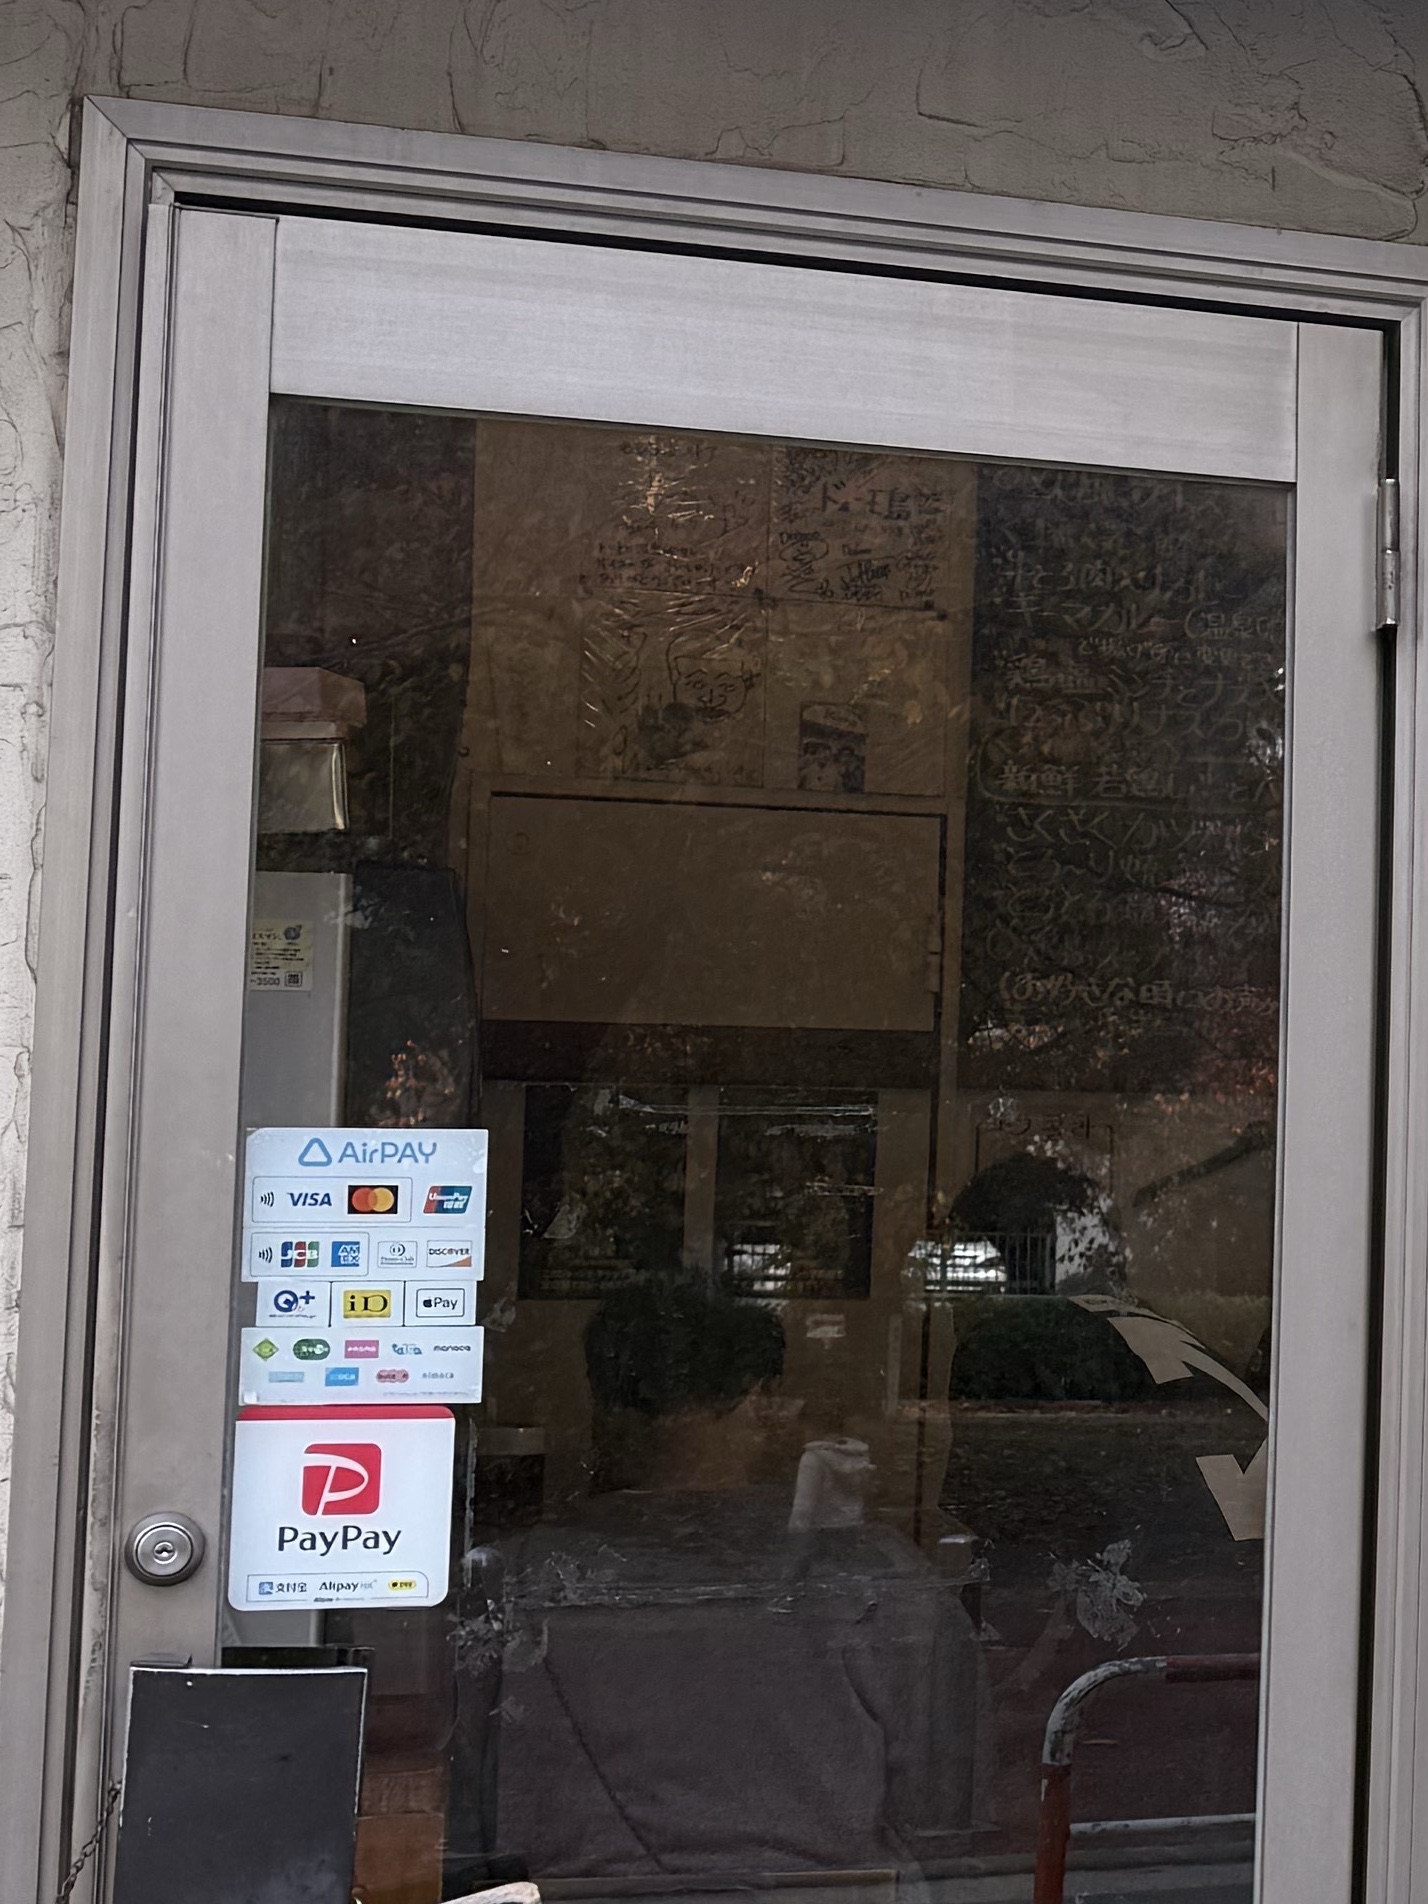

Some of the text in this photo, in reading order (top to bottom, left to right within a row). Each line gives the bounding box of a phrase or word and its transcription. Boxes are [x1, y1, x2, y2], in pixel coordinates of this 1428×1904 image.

[337, 1141, 438, 1165] AirPAY
[287, 1192, 333, 1208] VISA
[428, 1247, 470, 1256] DISCOVER
[348, 1294, 388, 1313] iD
[433, 1296, 458, 1311] Pay
[277, 1525, 402, 1557] PayPay
[319, 1581, 360, 1593] Alipay
